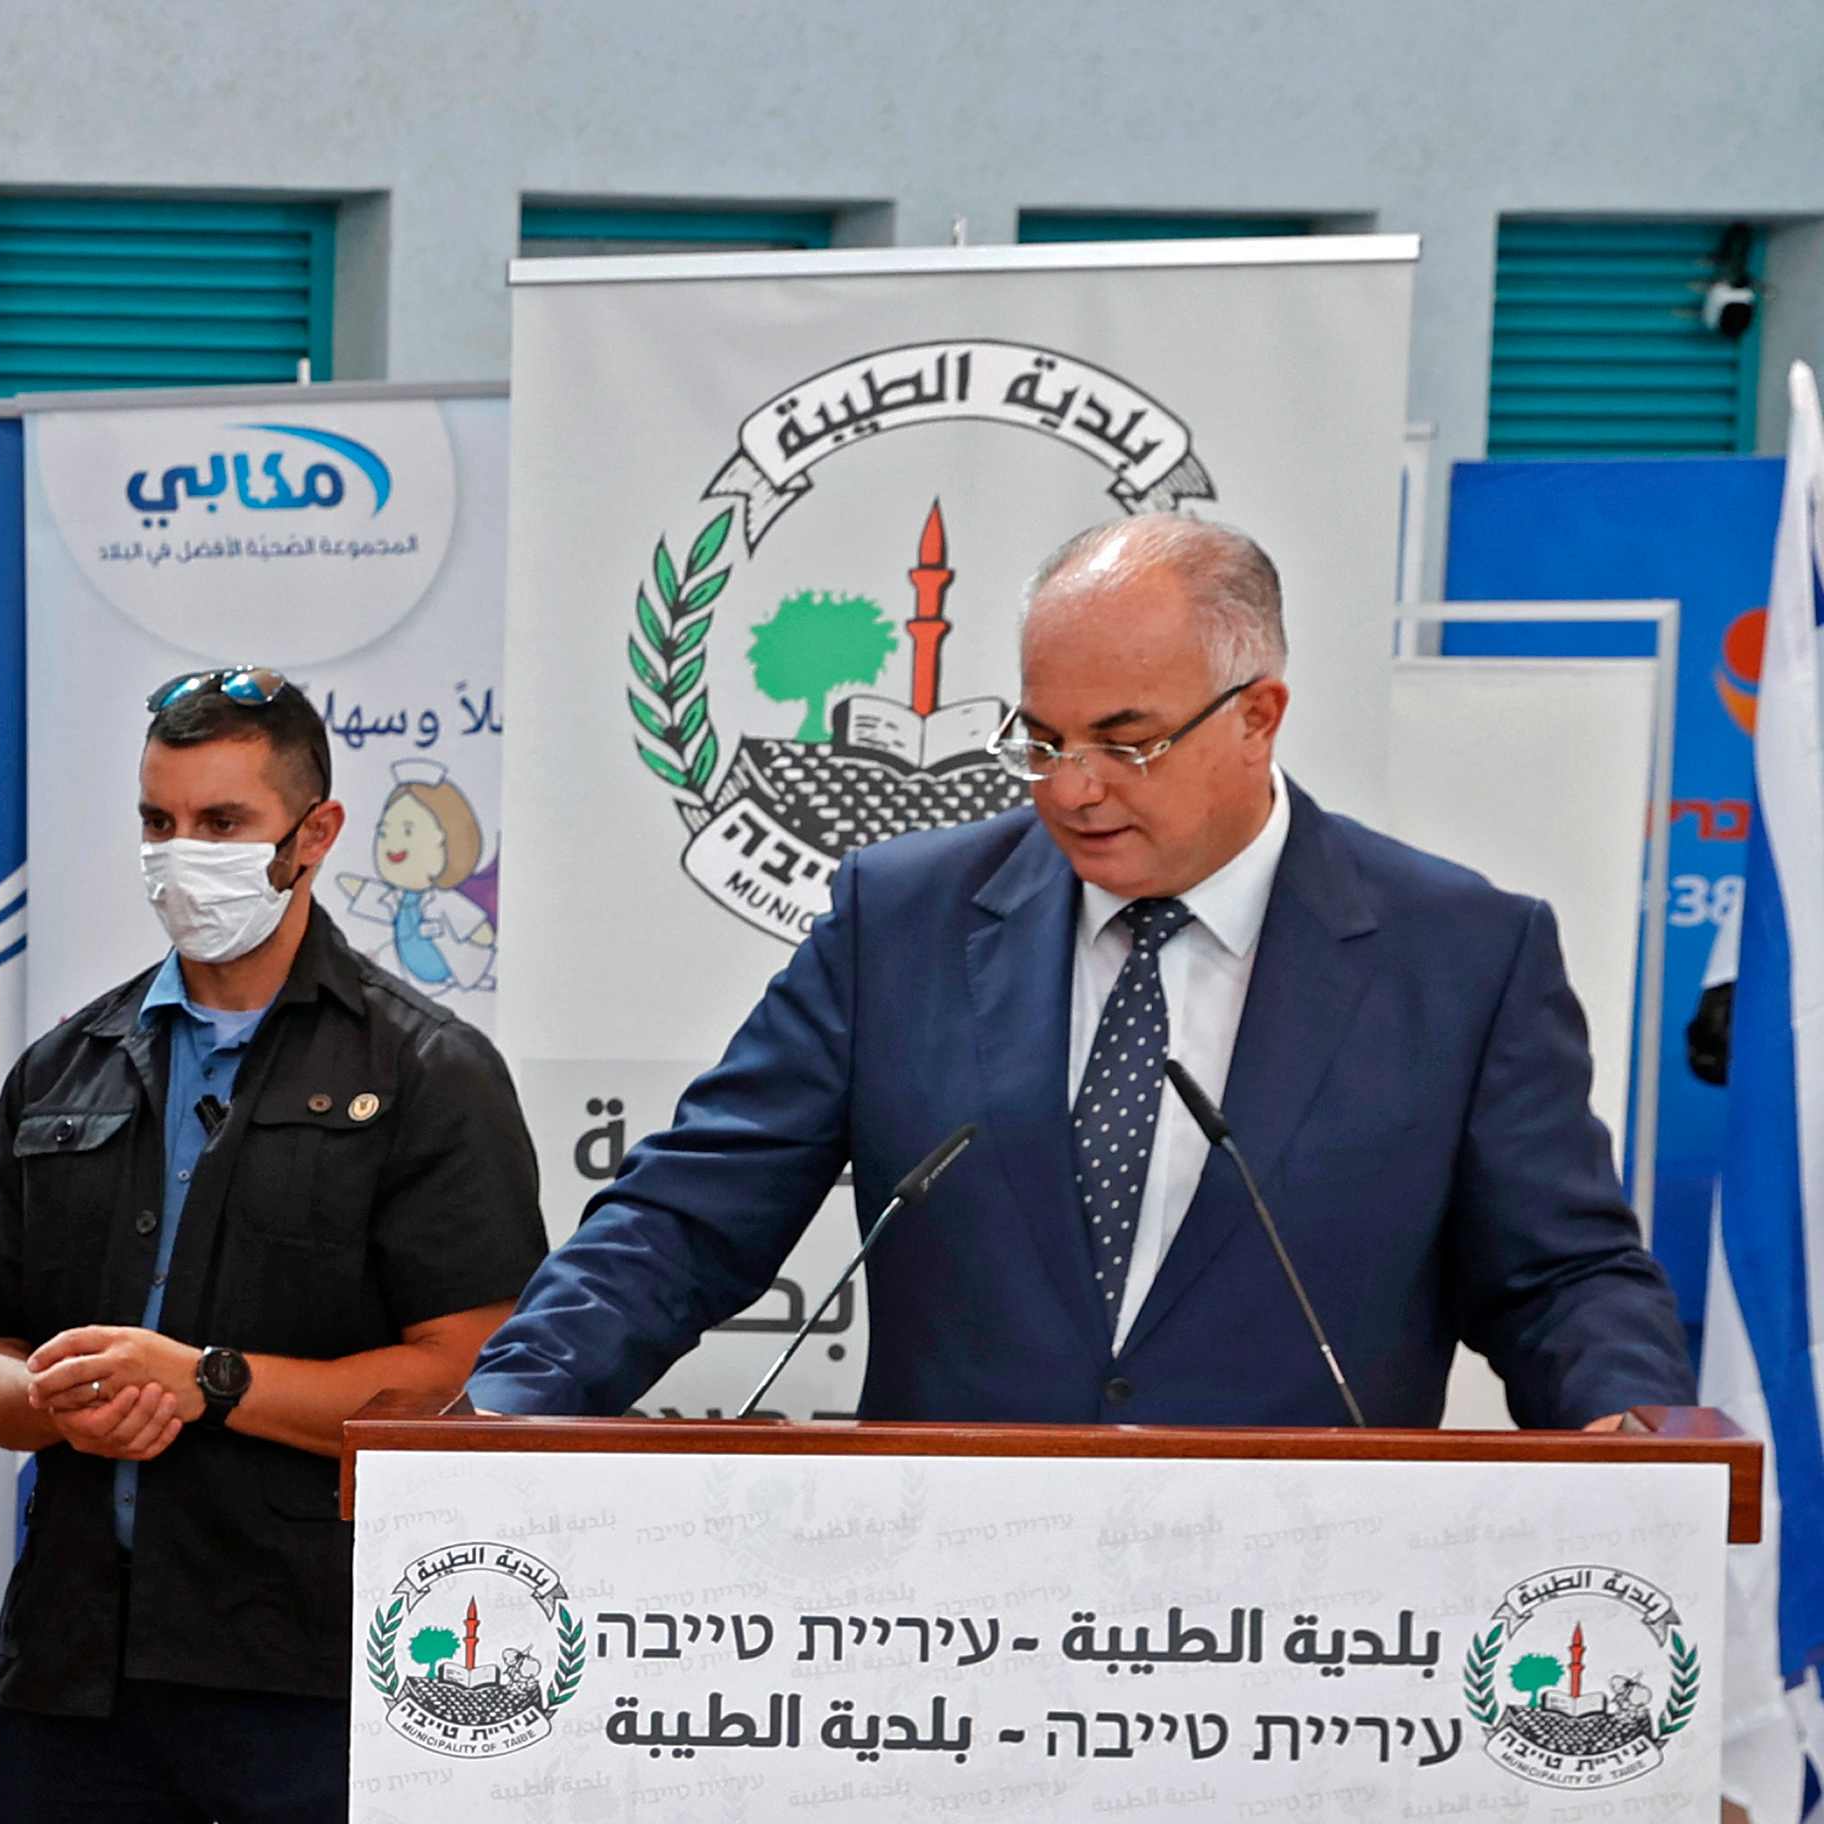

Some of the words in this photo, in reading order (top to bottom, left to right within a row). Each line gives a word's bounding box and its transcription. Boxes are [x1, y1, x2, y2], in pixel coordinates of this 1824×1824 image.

[776, 351, 972, 460] الطيبة
[1003, 356, 1162, 474] بلدية
[126, 452, 344, 528] مكابي
[722, 811, 834, 888] ייבה
[724, 870, 817, 934] MUNIC
[417, 1547, 485, 1582] الطيبة
[496, 1549, 551, 1588] بلدية
[596, 1612, 774, 1661] טייבה
[1061, 1606, 1264, 1675] الطيبة
[1285, 1610, 1441, 1680] بلدية
[400, 1701, 459, 1740] טייבה
[402, 1723, 477, 1753] MUNICIPALITY
[481, 1743, 497, 1753] OF
[502, 1730, 537, 1750] TAIBE
[470, 1708, 539, 1741] עיריית
[605, 1692, 802, 1759] الطيبة
[820, 1695, 973, 1765] بلدية
[1046, 1711, 1229, 1760] טייבה
[1252, 1714, 1464, 1767] עיריית
